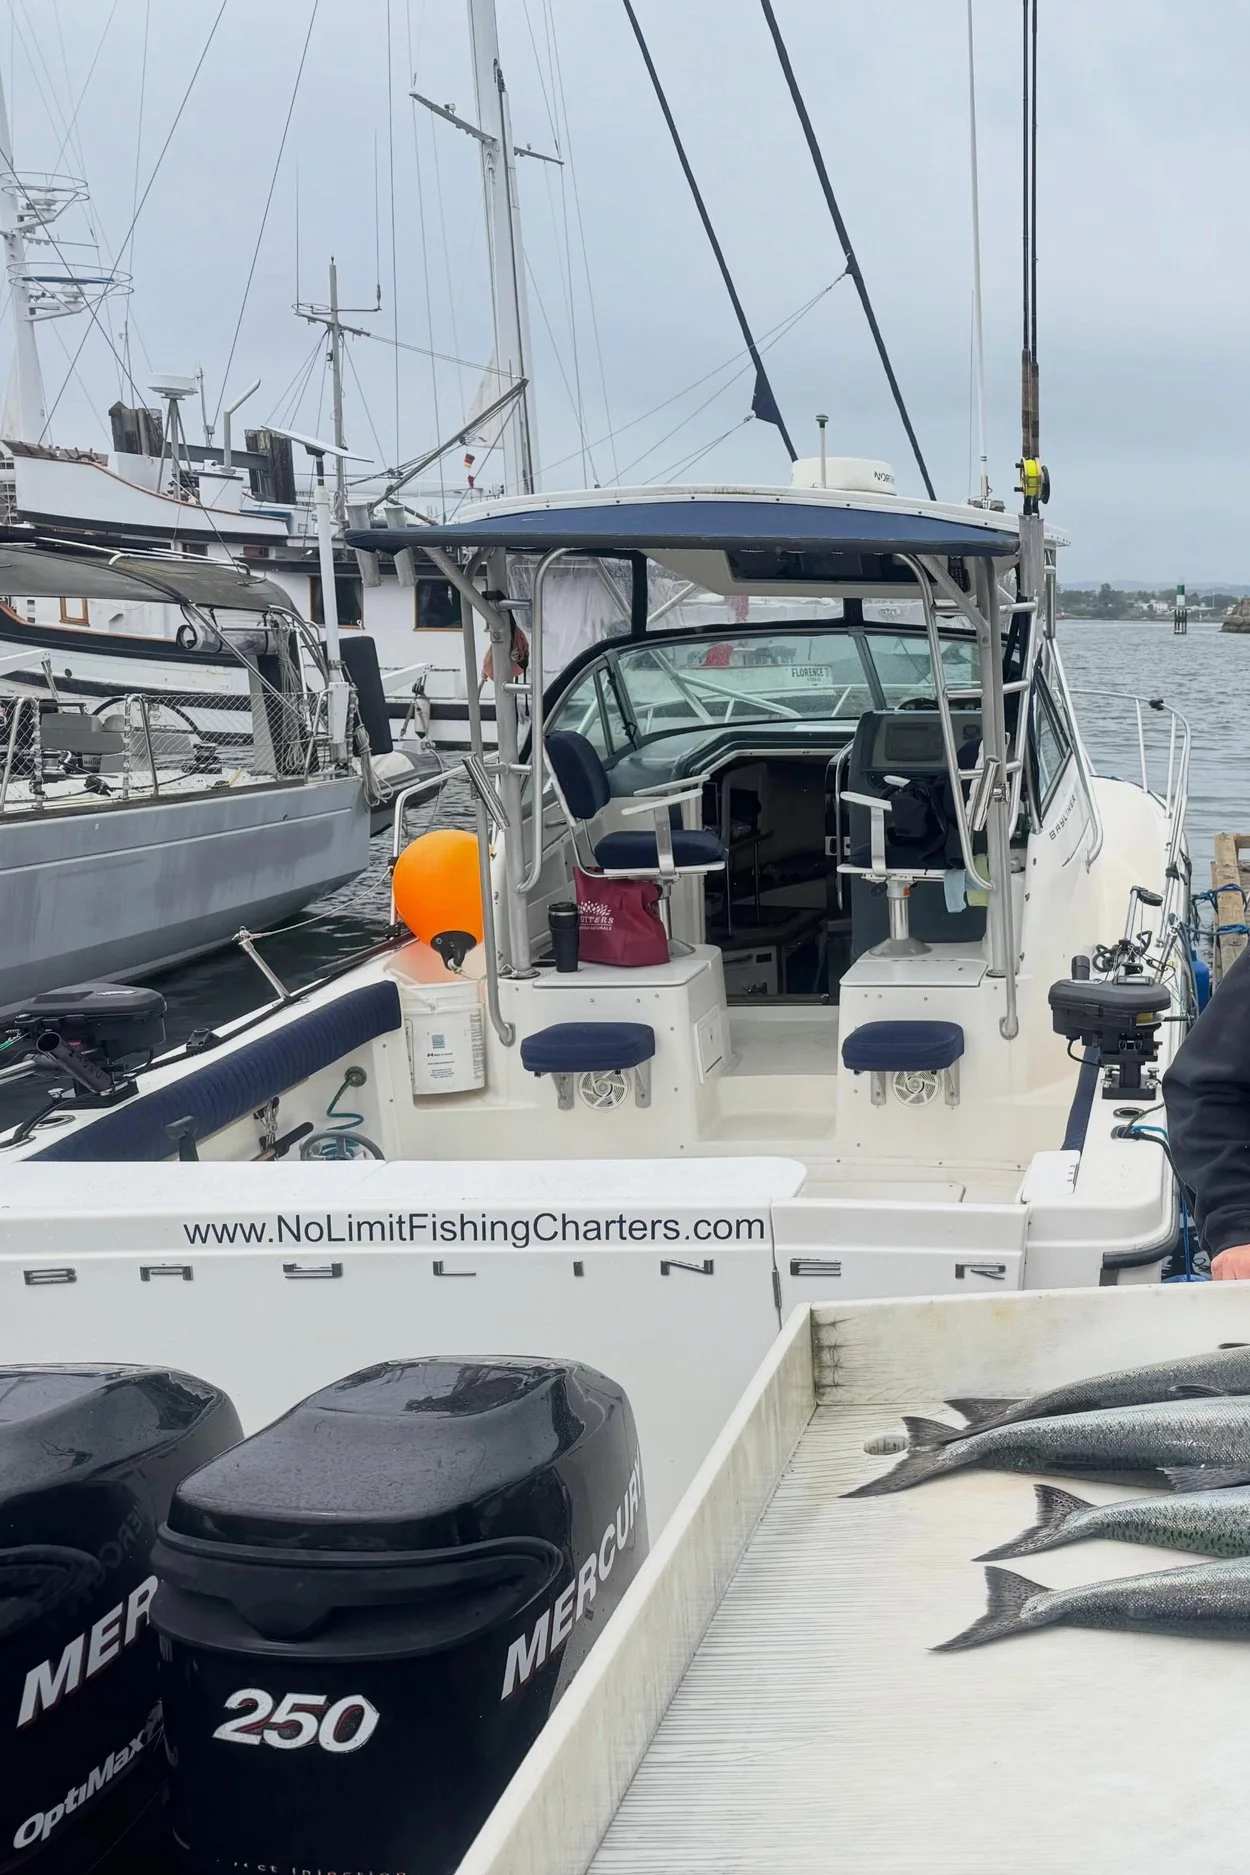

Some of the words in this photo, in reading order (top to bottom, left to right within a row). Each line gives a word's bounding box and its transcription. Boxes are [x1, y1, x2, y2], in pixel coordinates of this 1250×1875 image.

[791, 667, 824, 677] FLORENCE
[1049, 794, 1076, 840] BAYLINER
[183, 1213, 766, 1249] www.NoLimitFishingCharters.com
[501, 1445, 641, 1701] MERCURY
[212, 1687, 381, 1754] 250
[13, 1728, 145, 1850] OptiMax
